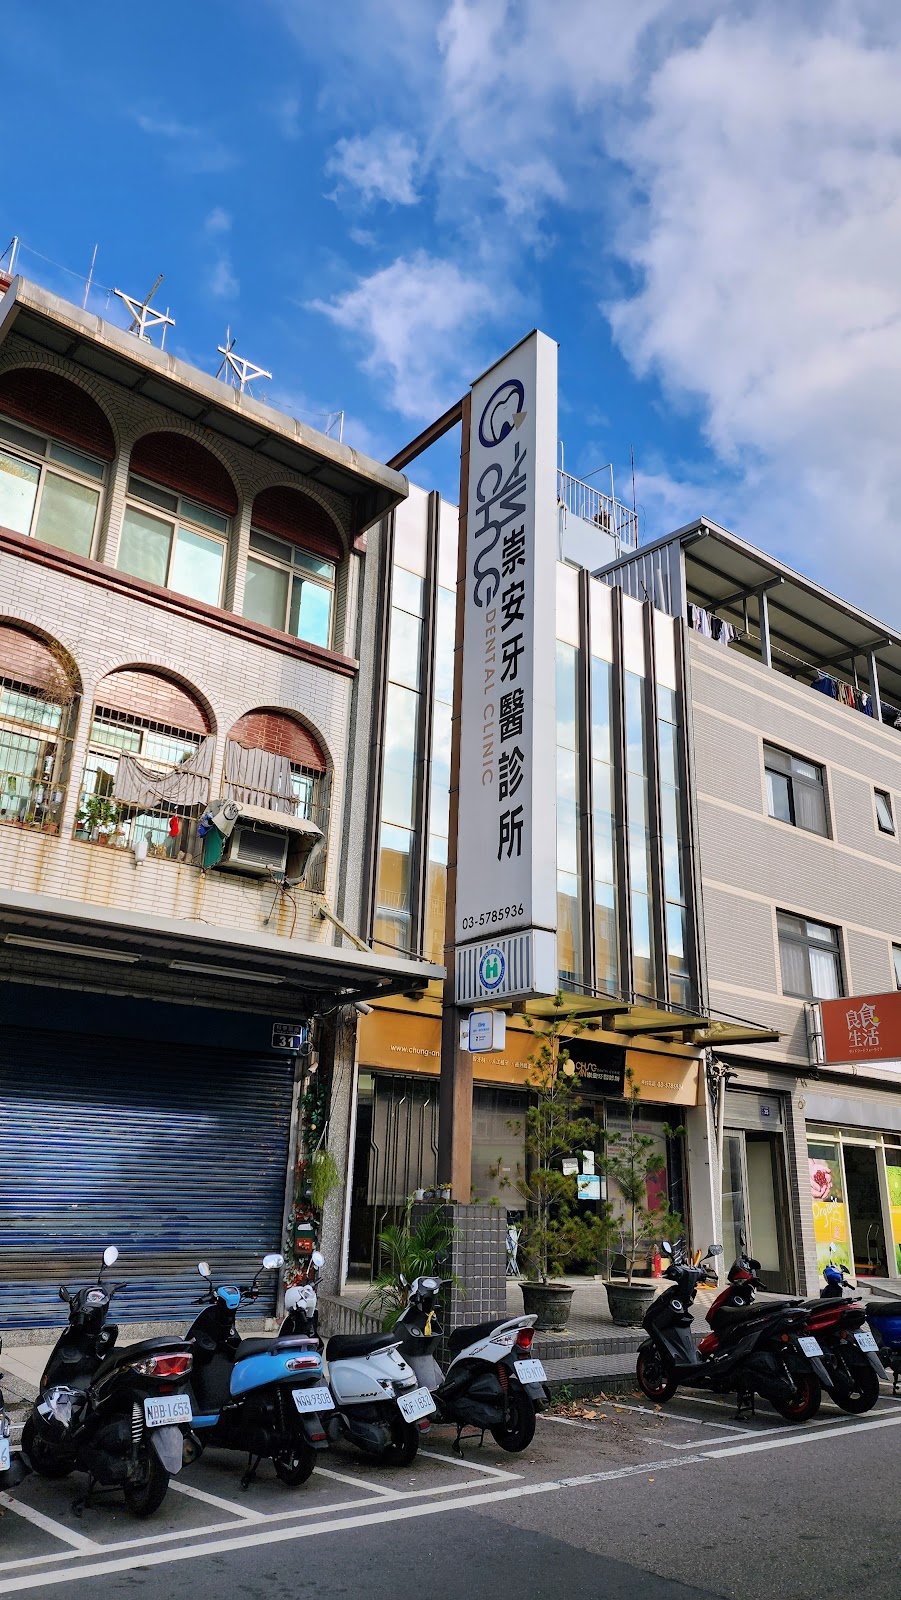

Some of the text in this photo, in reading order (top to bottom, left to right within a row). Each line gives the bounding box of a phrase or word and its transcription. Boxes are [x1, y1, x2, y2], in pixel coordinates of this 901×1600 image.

[482, 608, 496, 787] DENTAL CLINIC
[497, 524, 525, 862] 崇安牙醫診所
[462, 903, 524, 930] 03-5785936
[846, 1003, 881, 1030] 良食
[279, 1036, 294, 1048] 31
[849, 1026, 880, 1048] 生活
[146, 1401, 190, 1420] NBB-1653
